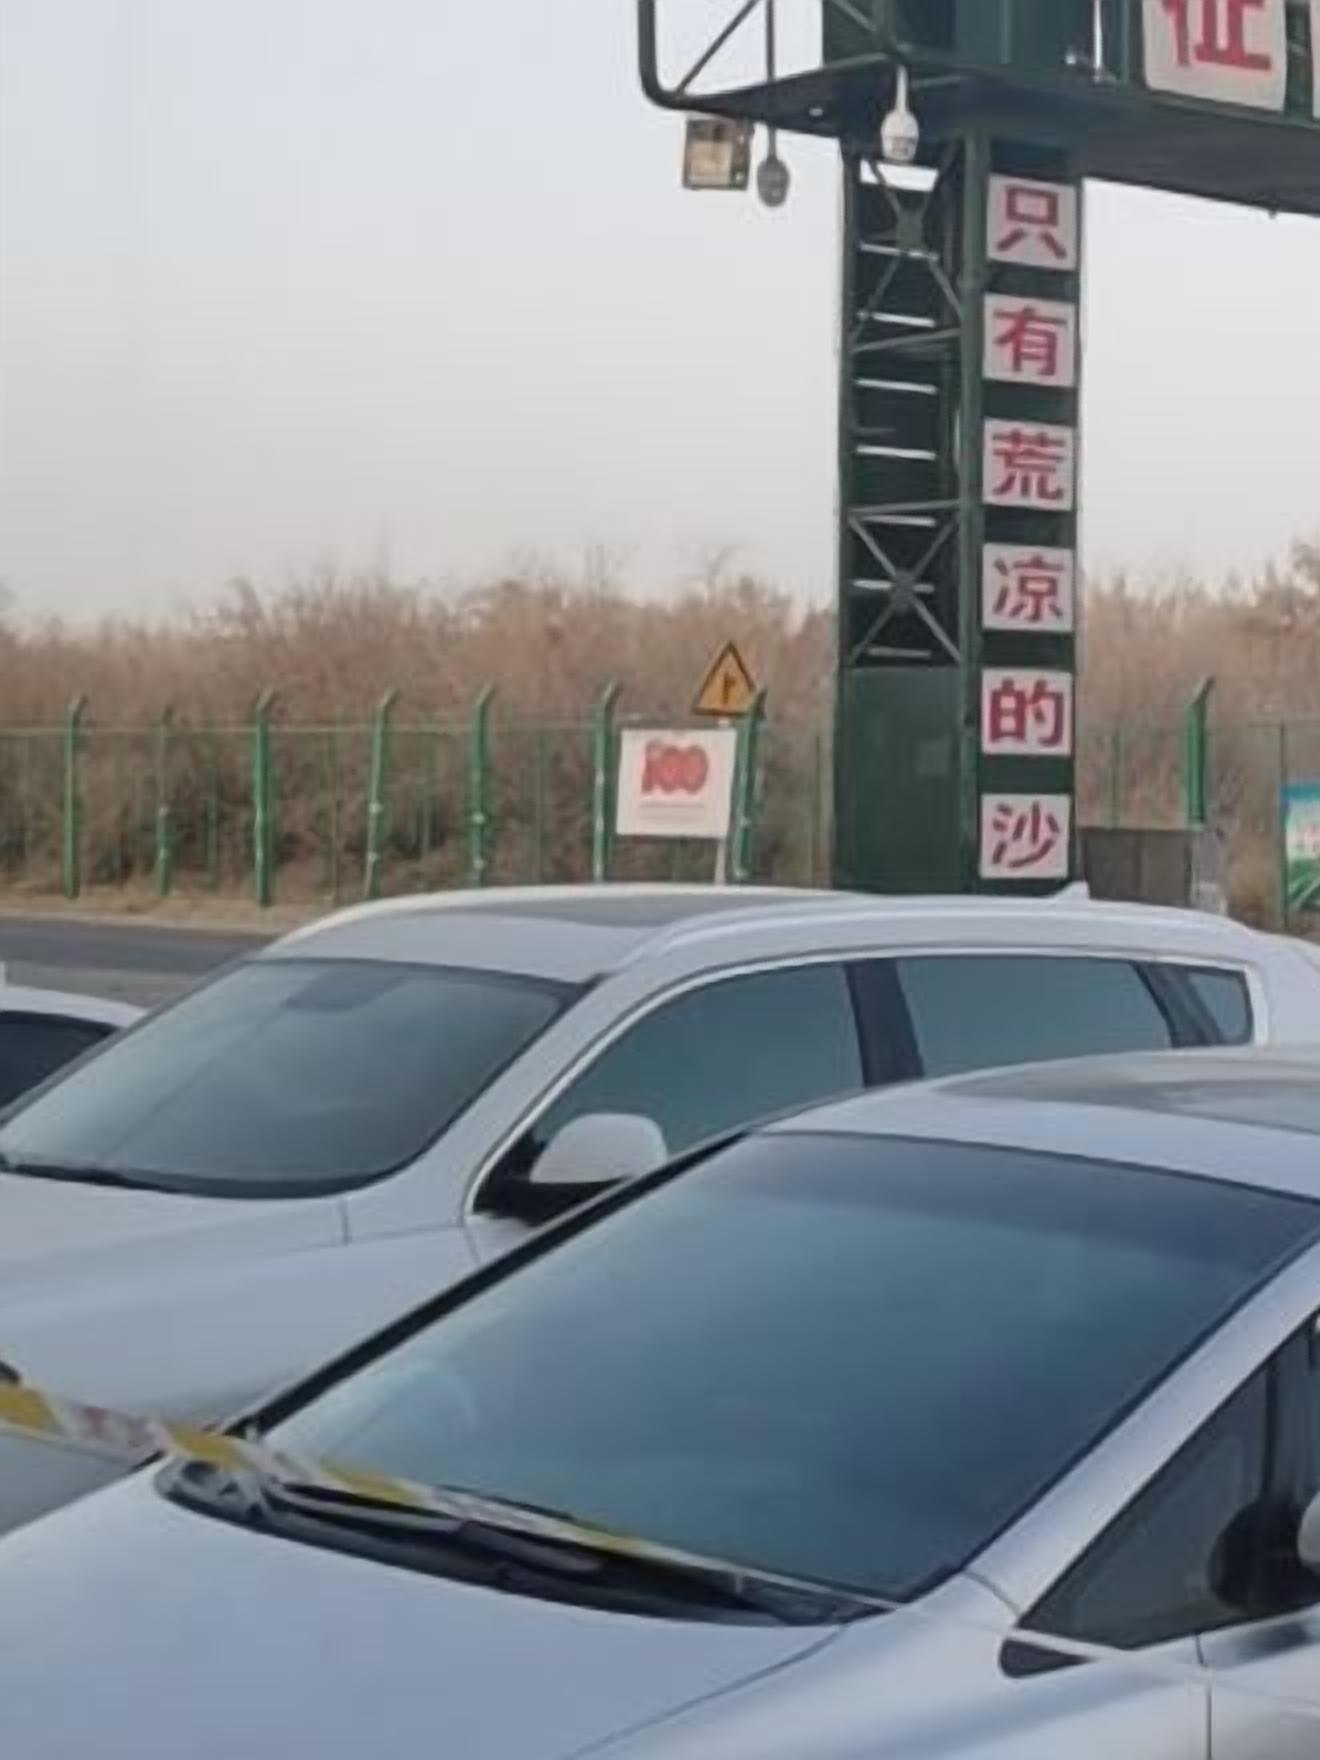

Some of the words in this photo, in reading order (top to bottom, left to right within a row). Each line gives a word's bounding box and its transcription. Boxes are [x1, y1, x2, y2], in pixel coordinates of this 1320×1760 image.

[987, 187, 1068, 869] 只有荒凉的沙
